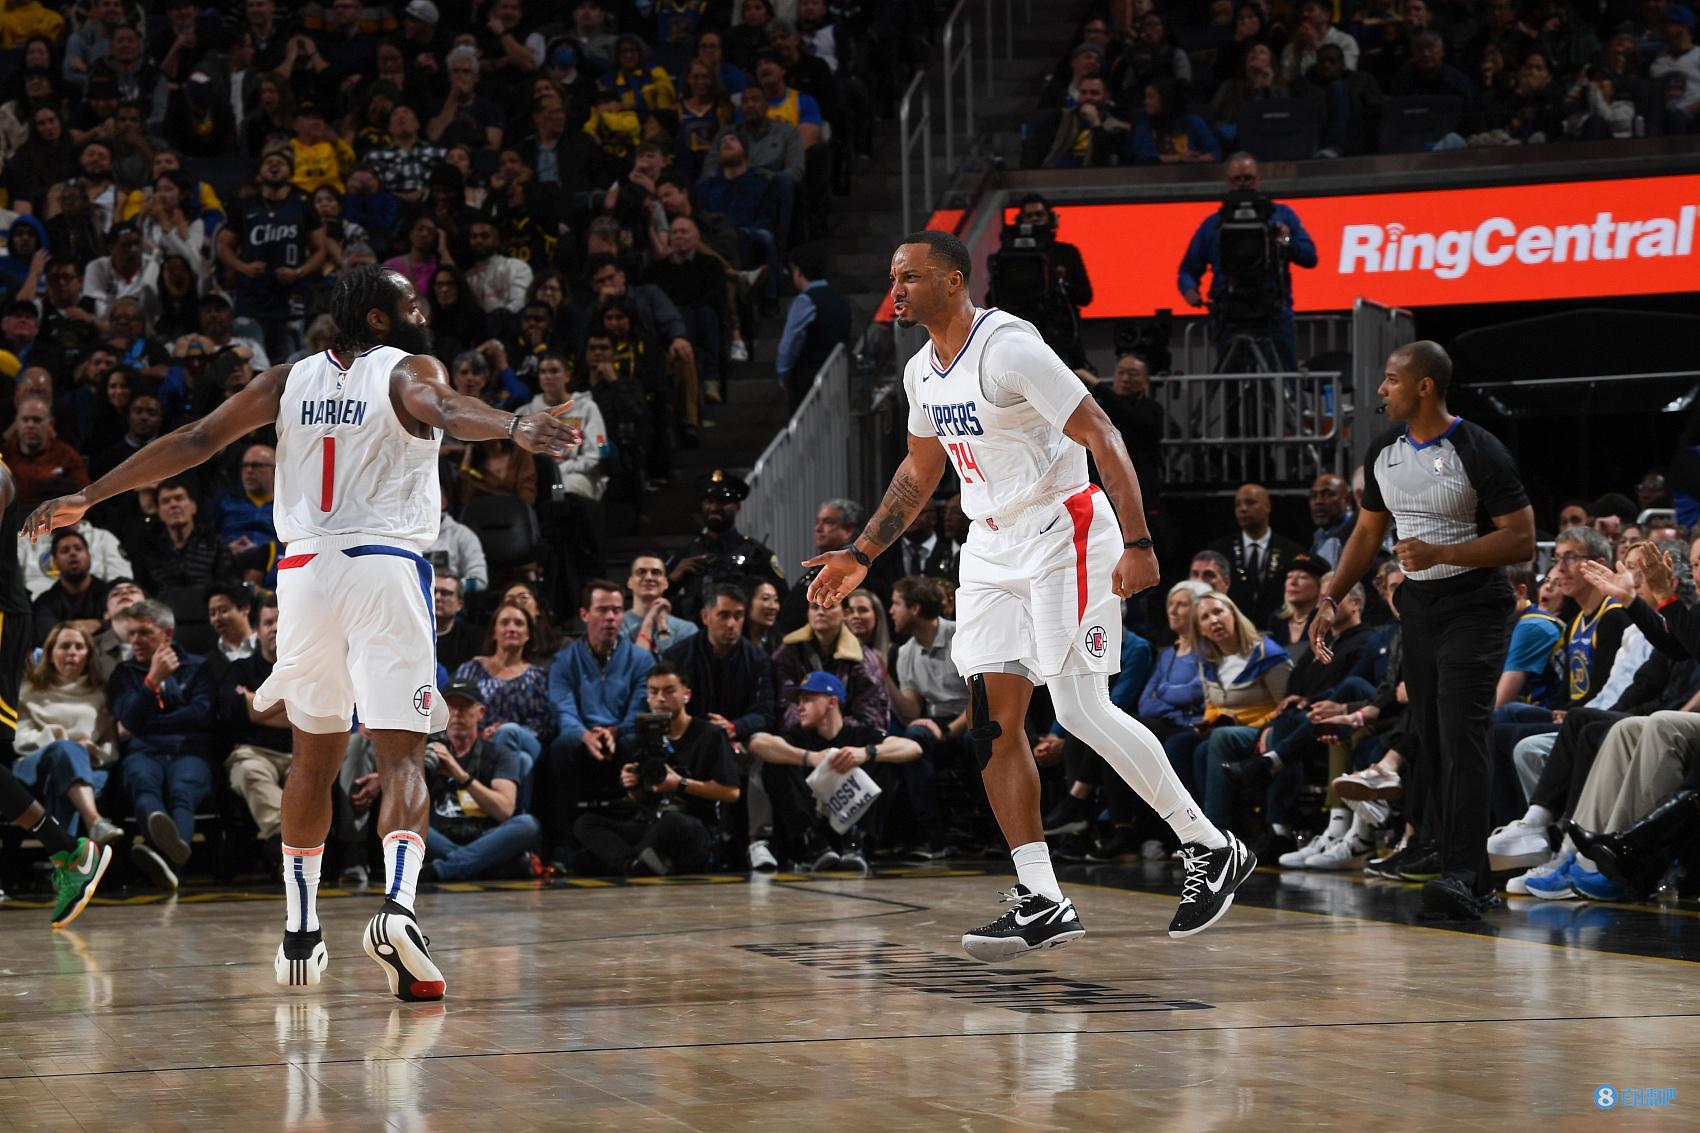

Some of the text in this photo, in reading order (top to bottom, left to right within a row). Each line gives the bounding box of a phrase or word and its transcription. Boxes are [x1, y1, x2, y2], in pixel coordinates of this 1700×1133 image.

[250, 224, 299, 246] Clips
[286, 244, 298, 265] 0
[1338, 205, 1697, 279] RingCentral
[320, 437, 335, 512] 1
